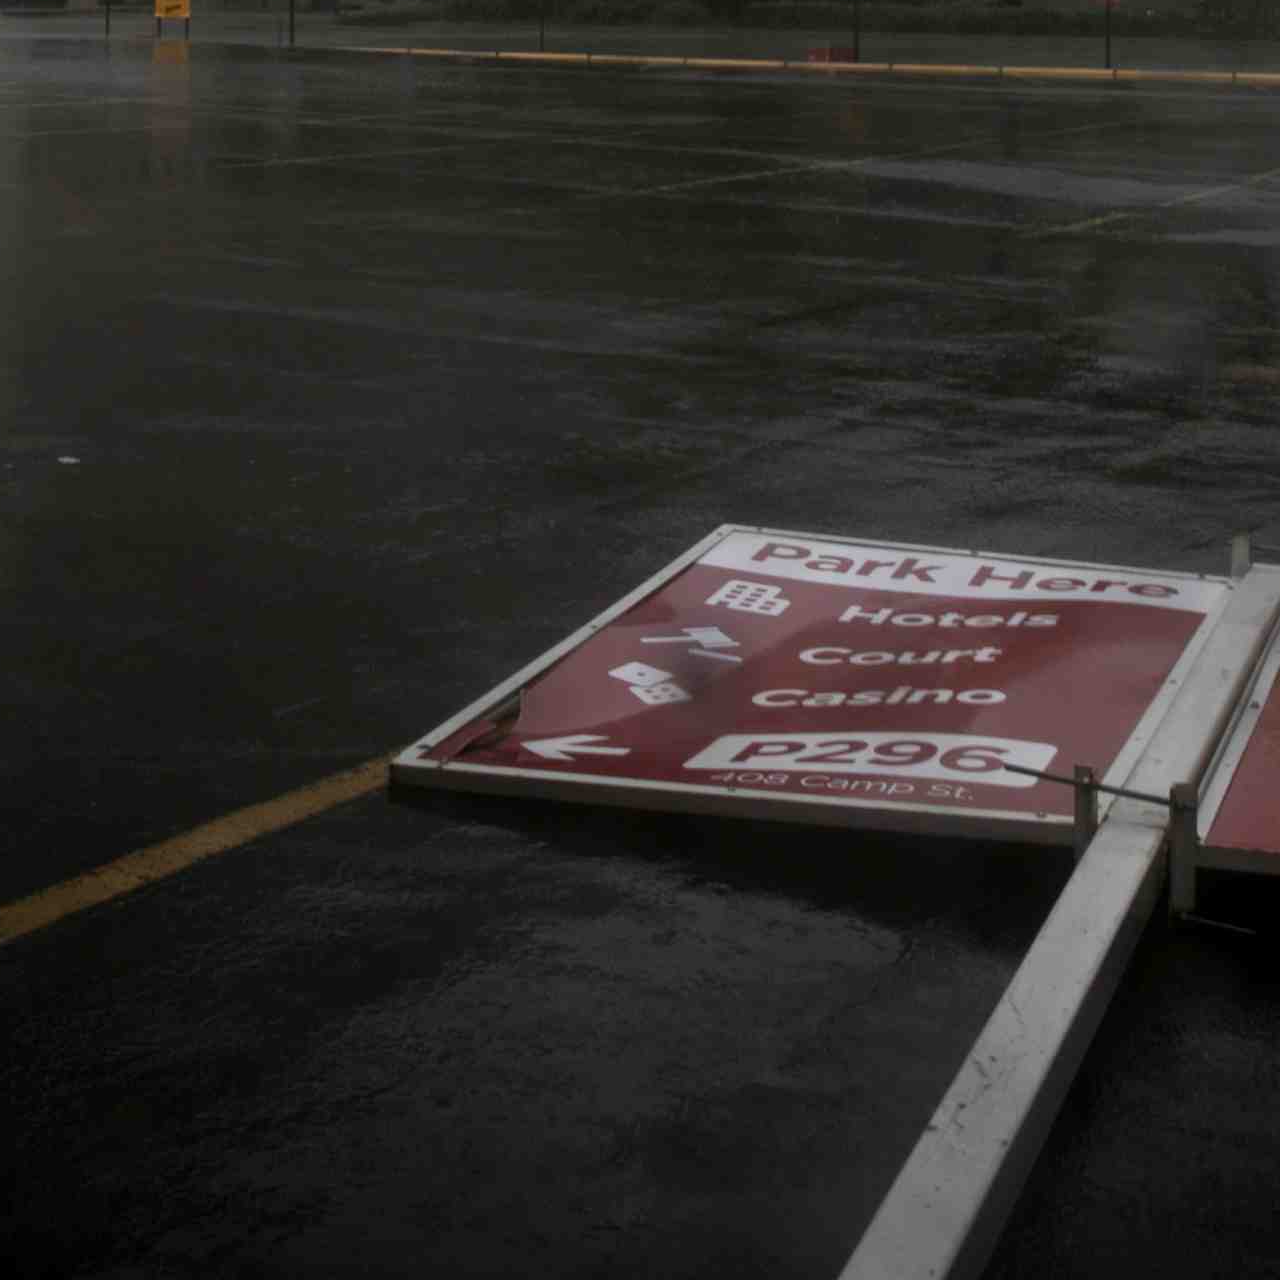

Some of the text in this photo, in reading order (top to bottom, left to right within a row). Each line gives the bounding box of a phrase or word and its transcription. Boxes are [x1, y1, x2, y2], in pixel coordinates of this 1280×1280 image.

[751, 542, 1180, 599] Park Here
[837, 604, 1059, 628] Hotels
[798, 645, 1003, 666] Court
[751, 685, 1007, 708] Casino
[730, 739, 1011, 773] P296
[799, 773, 916, 796] Camp
[927, 783, 975, 801] St.
